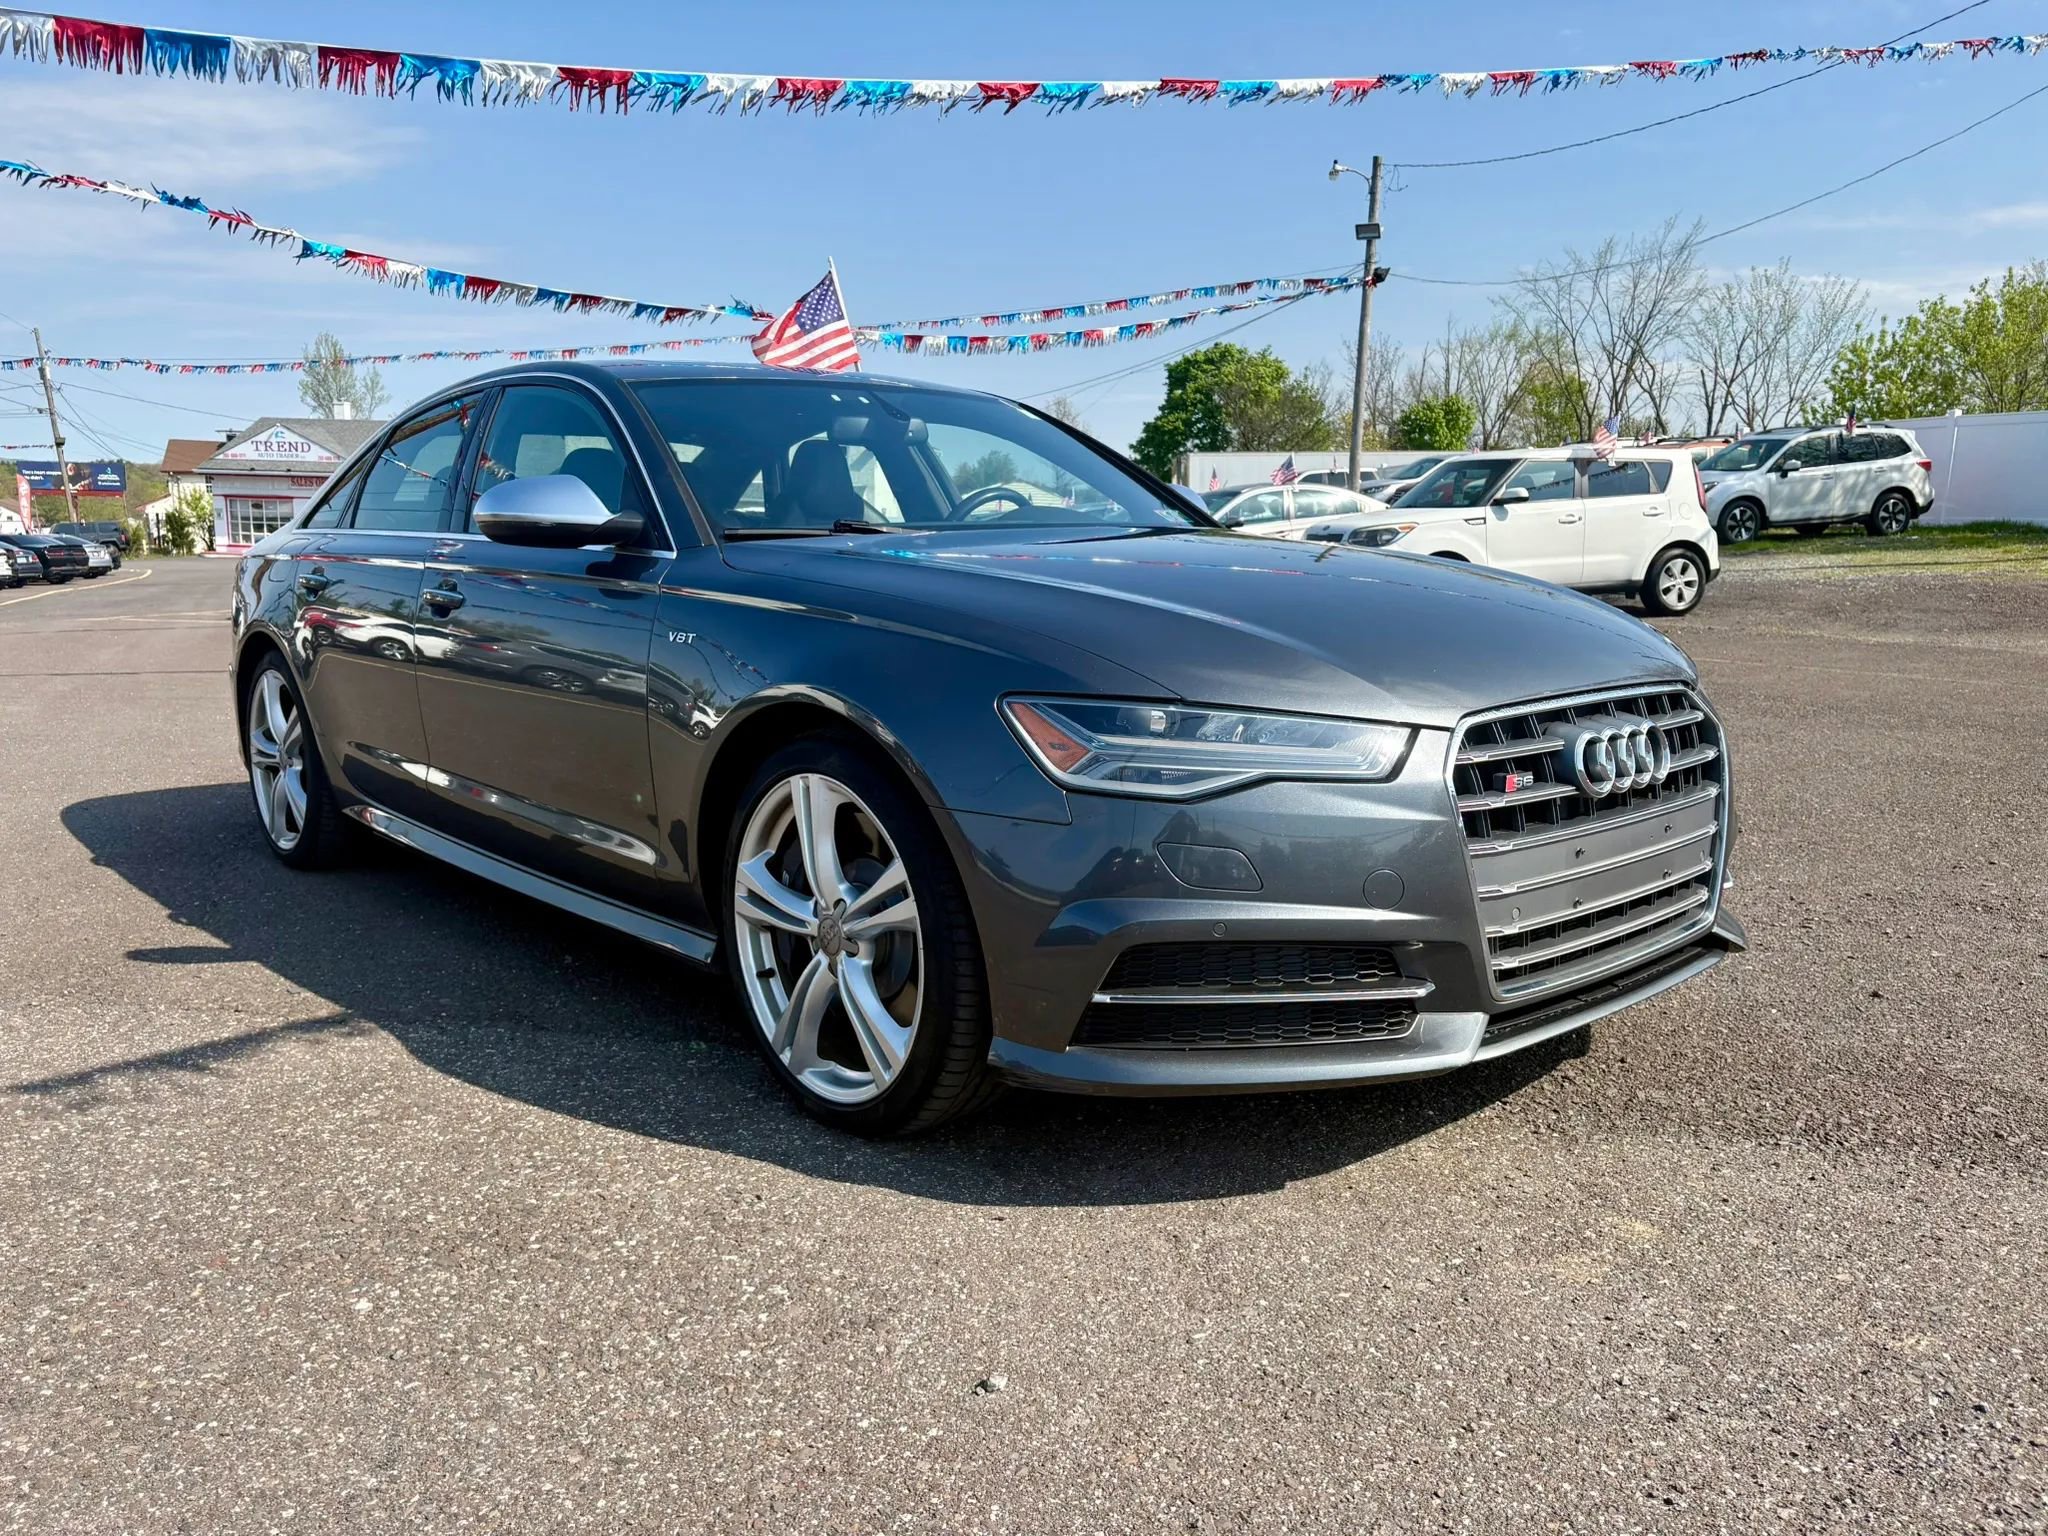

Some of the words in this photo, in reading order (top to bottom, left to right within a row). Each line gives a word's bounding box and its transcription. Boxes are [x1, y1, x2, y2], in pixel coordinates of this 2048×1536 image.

[251, 440, 311, 453] TREND
[669, 631, 697, 644] V8T
[1513, 775, 1534, 789] S6
